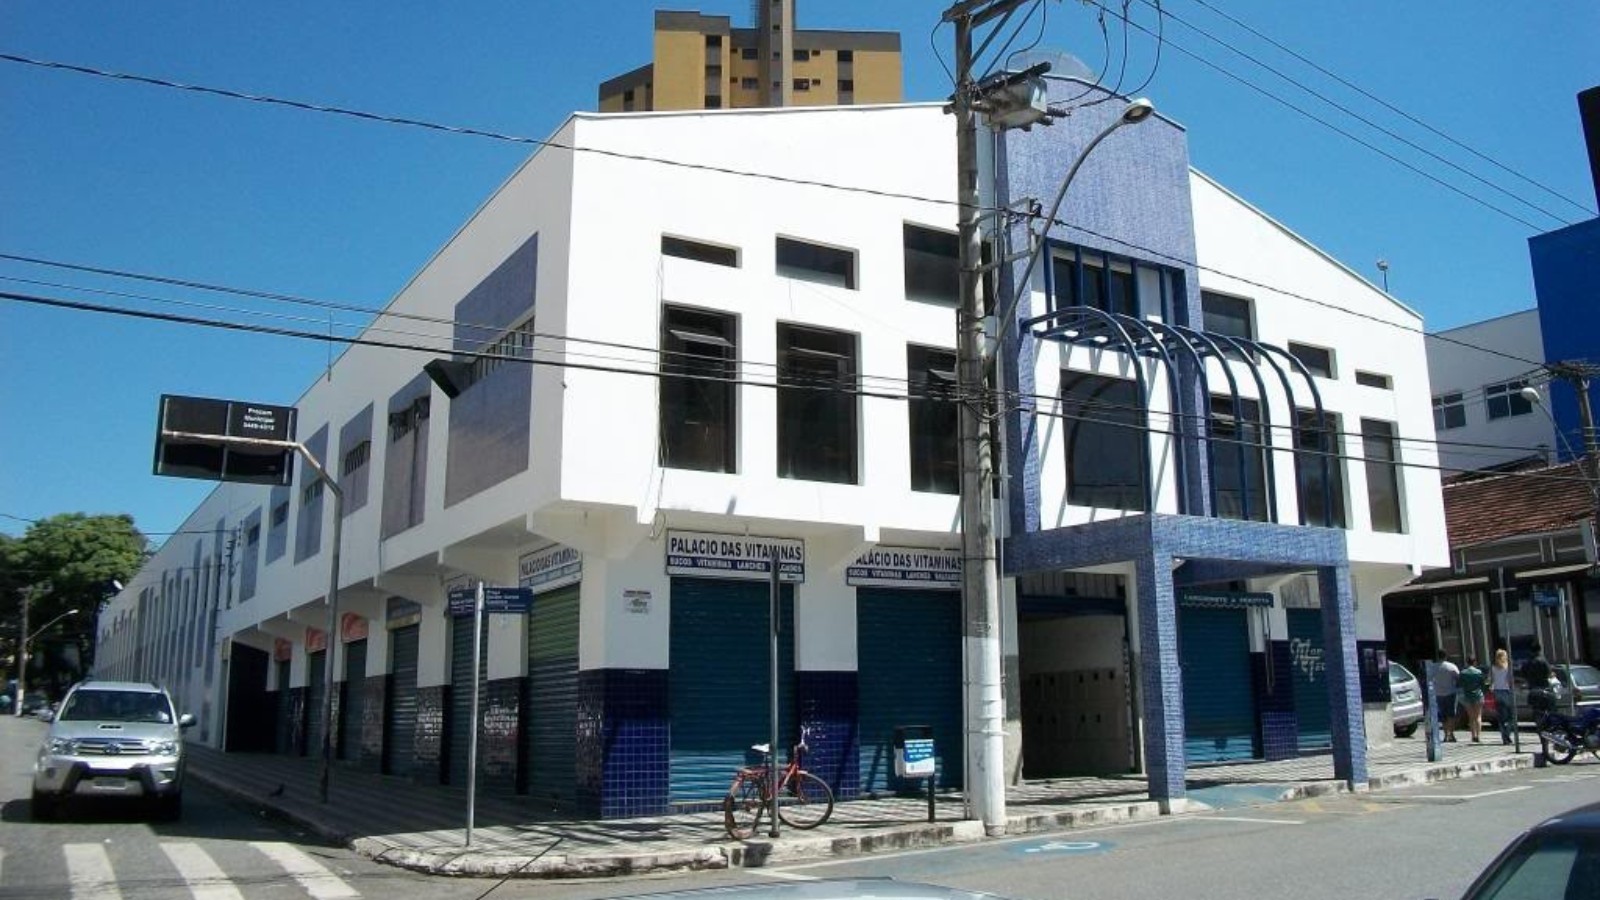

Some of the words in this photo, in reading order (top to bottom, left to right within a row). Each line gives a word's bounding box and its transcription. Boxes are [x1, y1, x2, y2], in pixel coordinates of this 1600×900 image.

[671, 537, 718, 555] PALACIO
[721, 540, 741, 557] DAS
[856, 549, 891, 566] ALÁCIO
[893, 553, 911, 568] DAS
[913, 554, 962, 571] VITAMINAS
